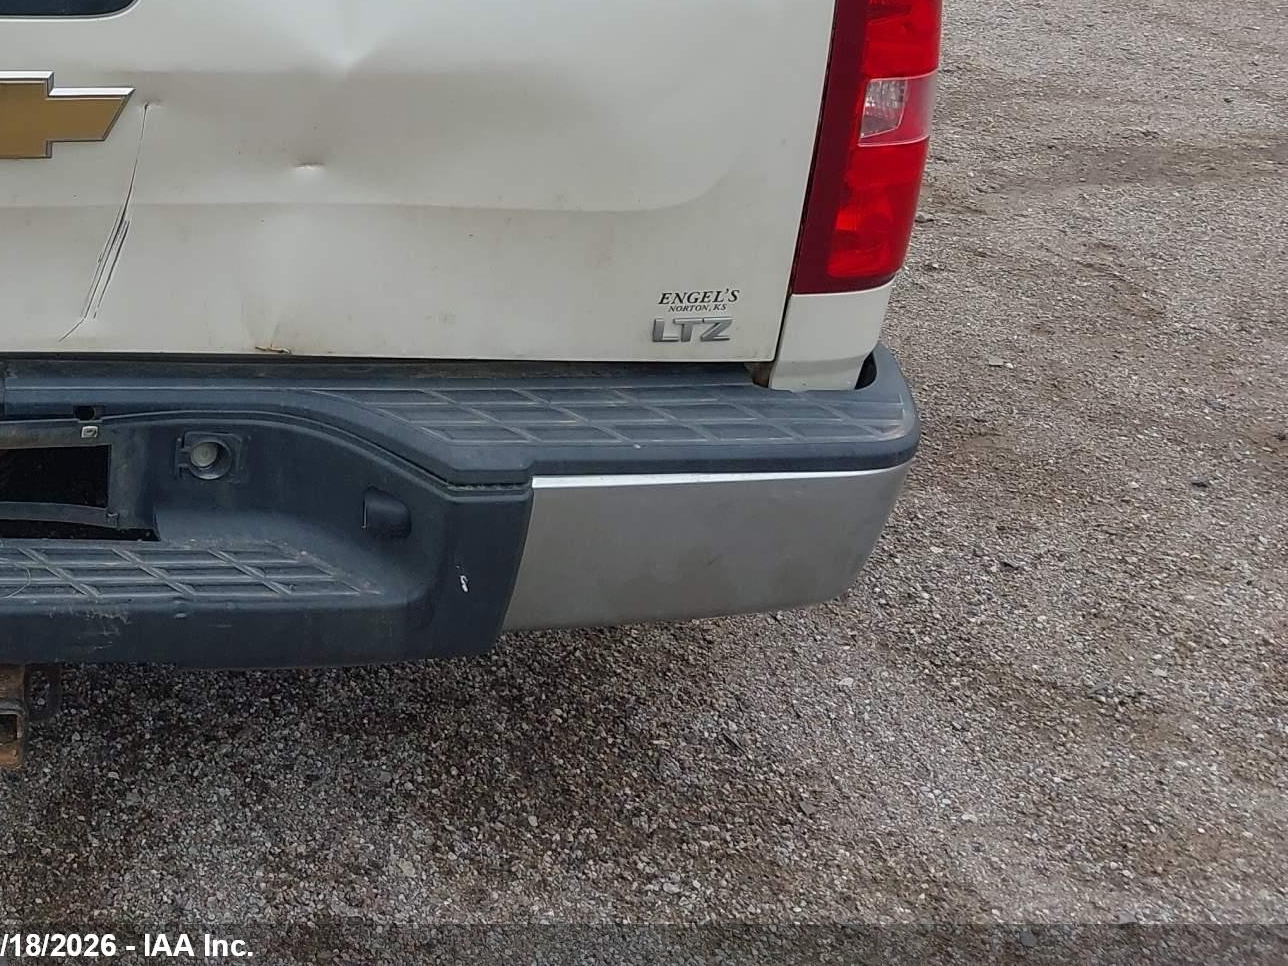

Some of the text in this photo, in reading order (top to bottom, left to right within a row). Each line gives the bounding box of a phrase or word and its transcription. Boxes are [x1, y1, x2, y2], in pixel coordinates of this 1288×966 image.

[658, 288, 740, 305] ENGEL'S
[713, 303, 727, 311] KS
[652, 316, 733, 342] LTZ
